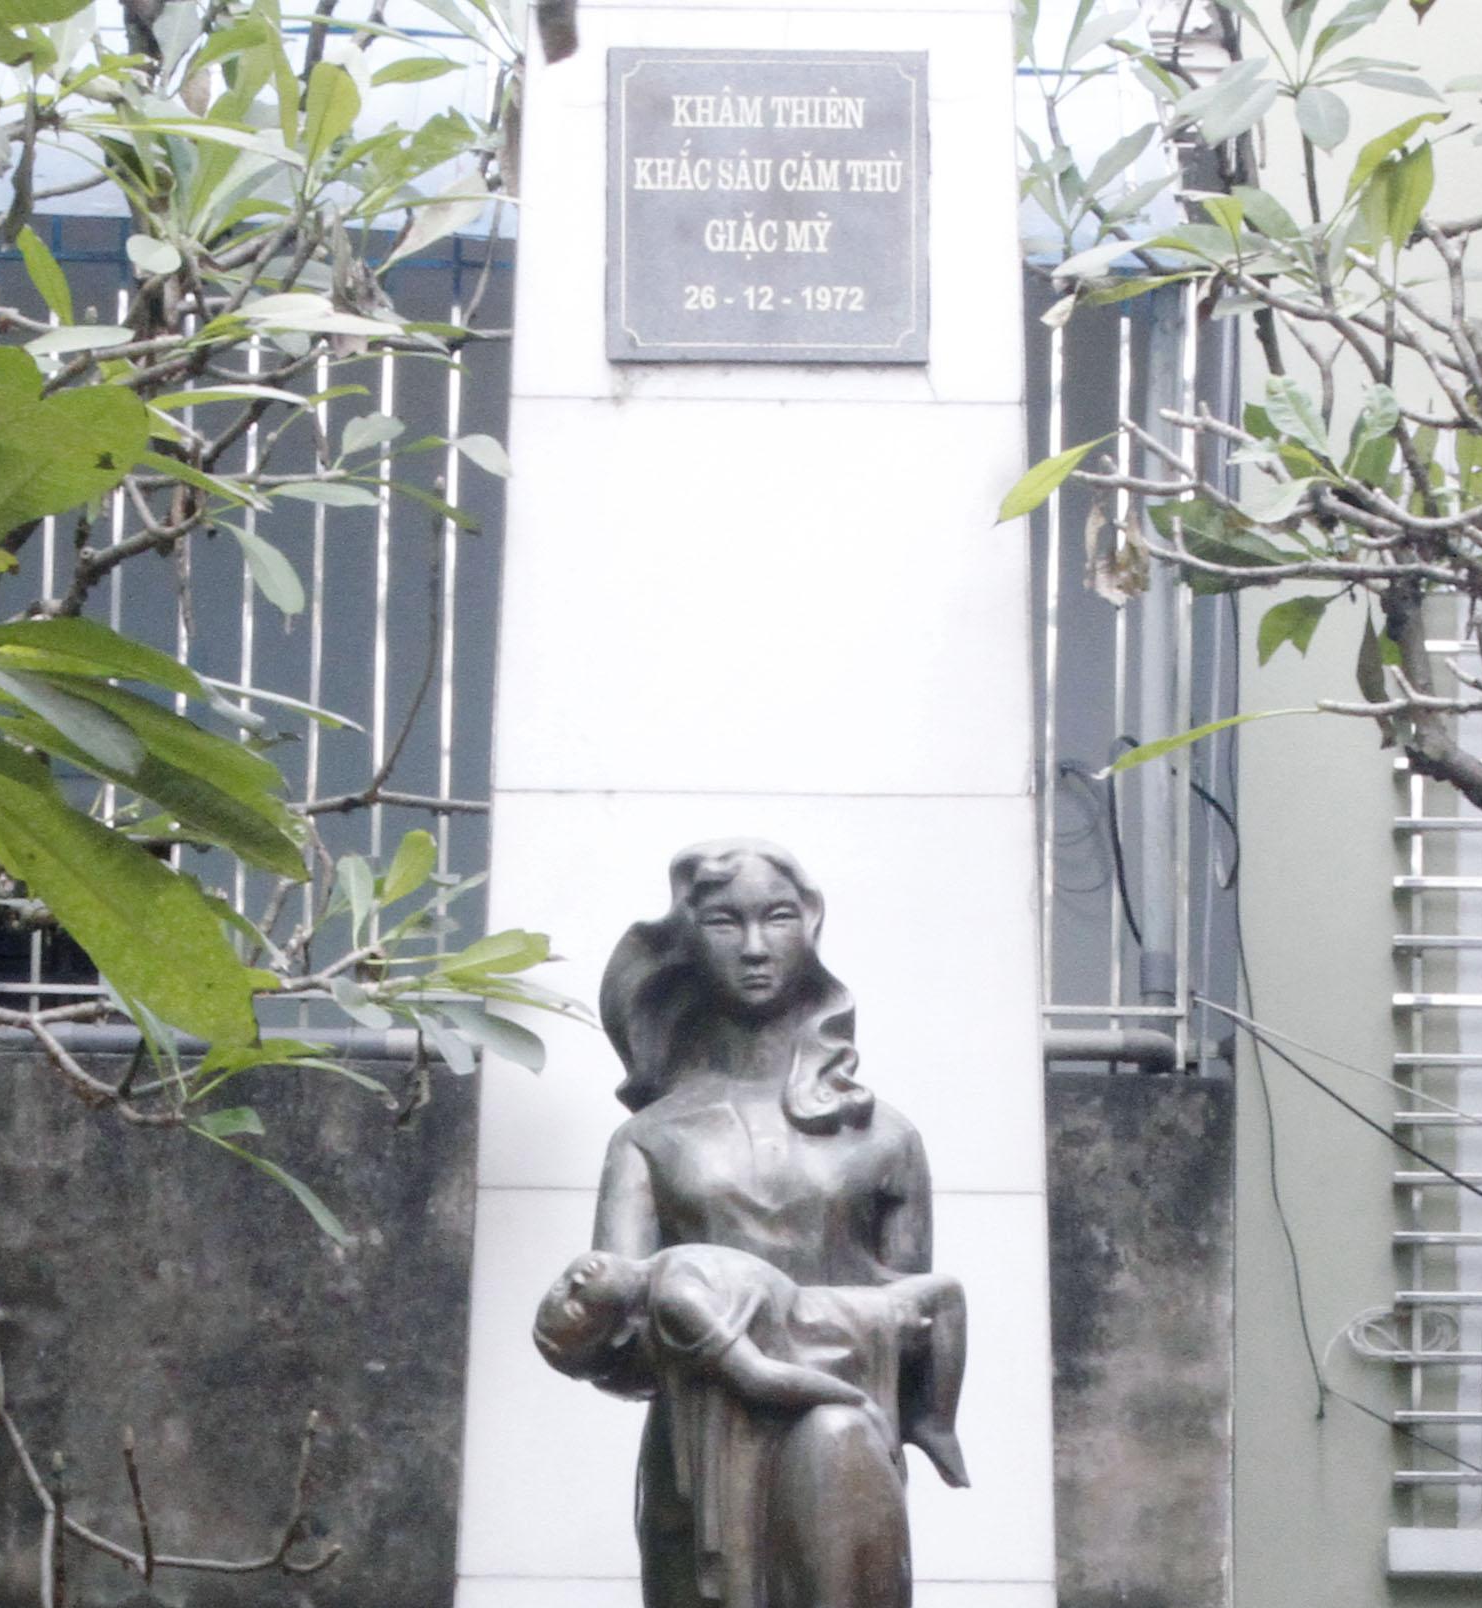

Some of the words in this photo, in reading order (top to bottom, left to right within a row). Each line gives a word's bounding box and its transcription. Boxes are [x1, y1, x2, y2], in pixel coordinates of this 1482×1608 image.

[671, 85, 764, 128] KHÂM
[770, 86, 865, 129] THIÊN
[633, 138, 711, 191] KHẮC
[718, 149, 773, 192] SÂU
[779, 150, 840, 193] CĂM
[846, 150, 903, 193] THÙ
[704, 211, 777, 261] GIẶC
[785, 212, 833, 253] MỸ
[683, 285, 716, 311] 26
[743, 285, 774, 311] 12
[801, 285, 864, 311] 1972
